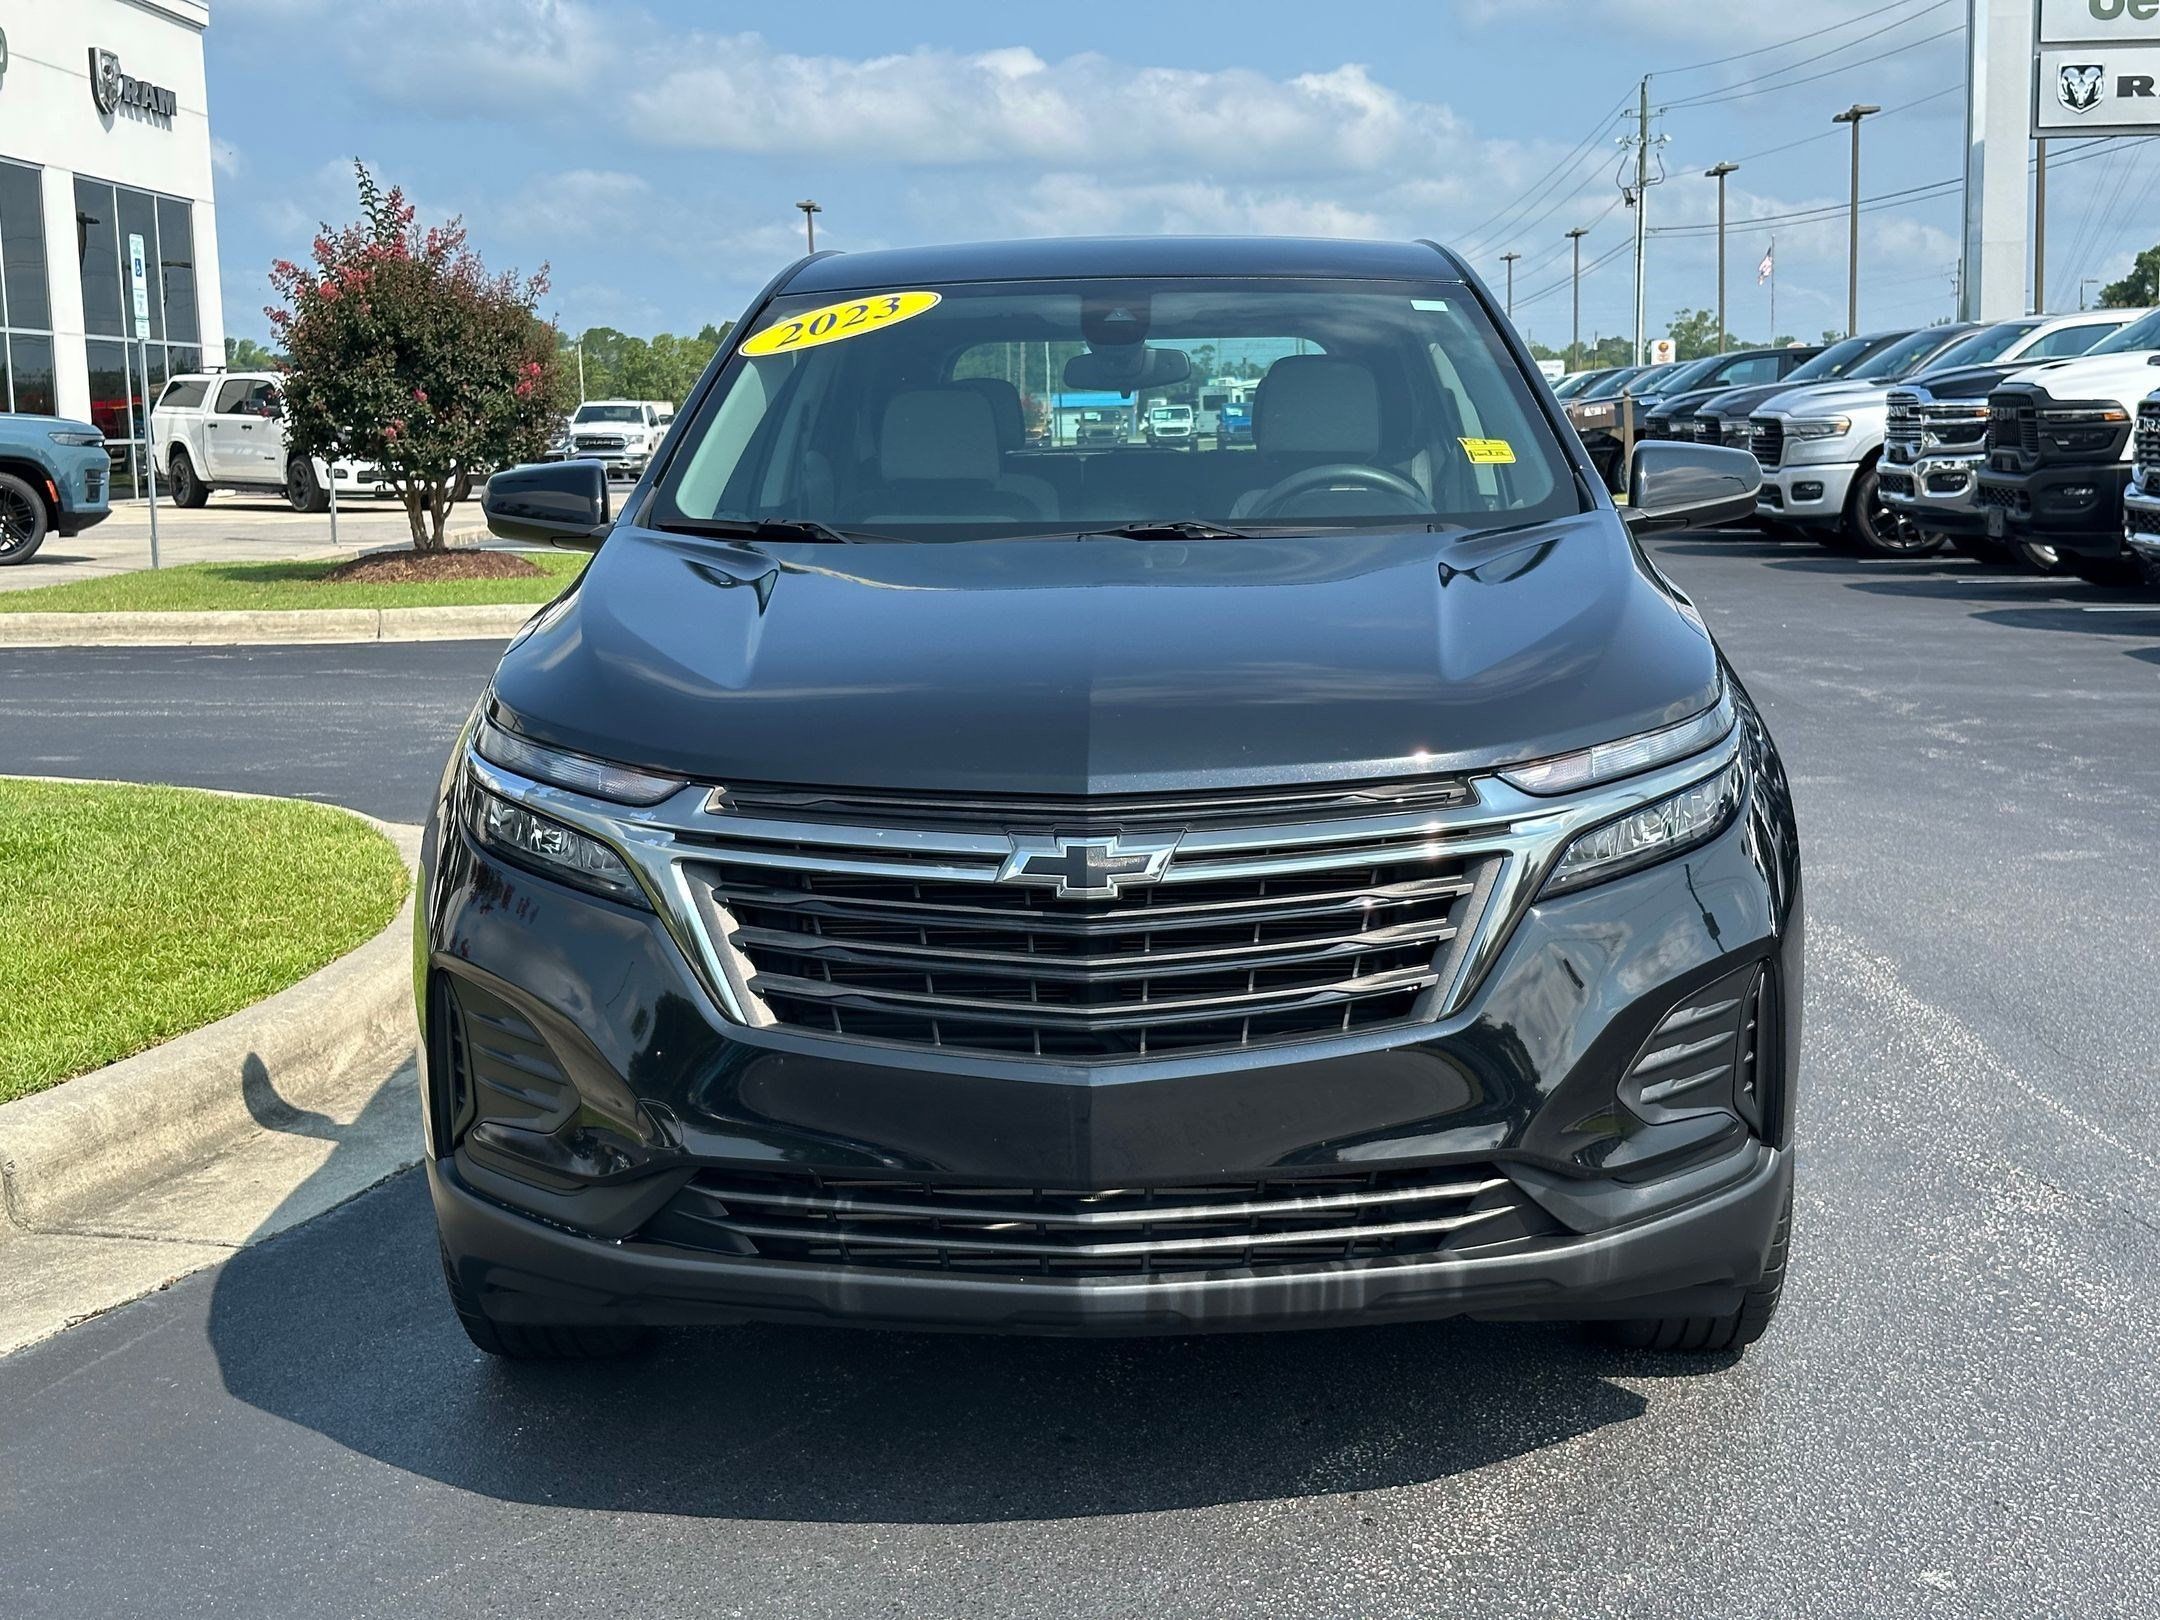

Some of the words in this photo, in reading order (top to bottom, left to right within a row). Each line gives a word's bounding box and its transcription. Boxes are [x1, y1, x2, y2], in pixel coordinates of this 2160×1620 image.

[121, 74, 177, 116] RAM
[2116, 75, 2160, 98] R
[776, 297, 901, 348] 2023
